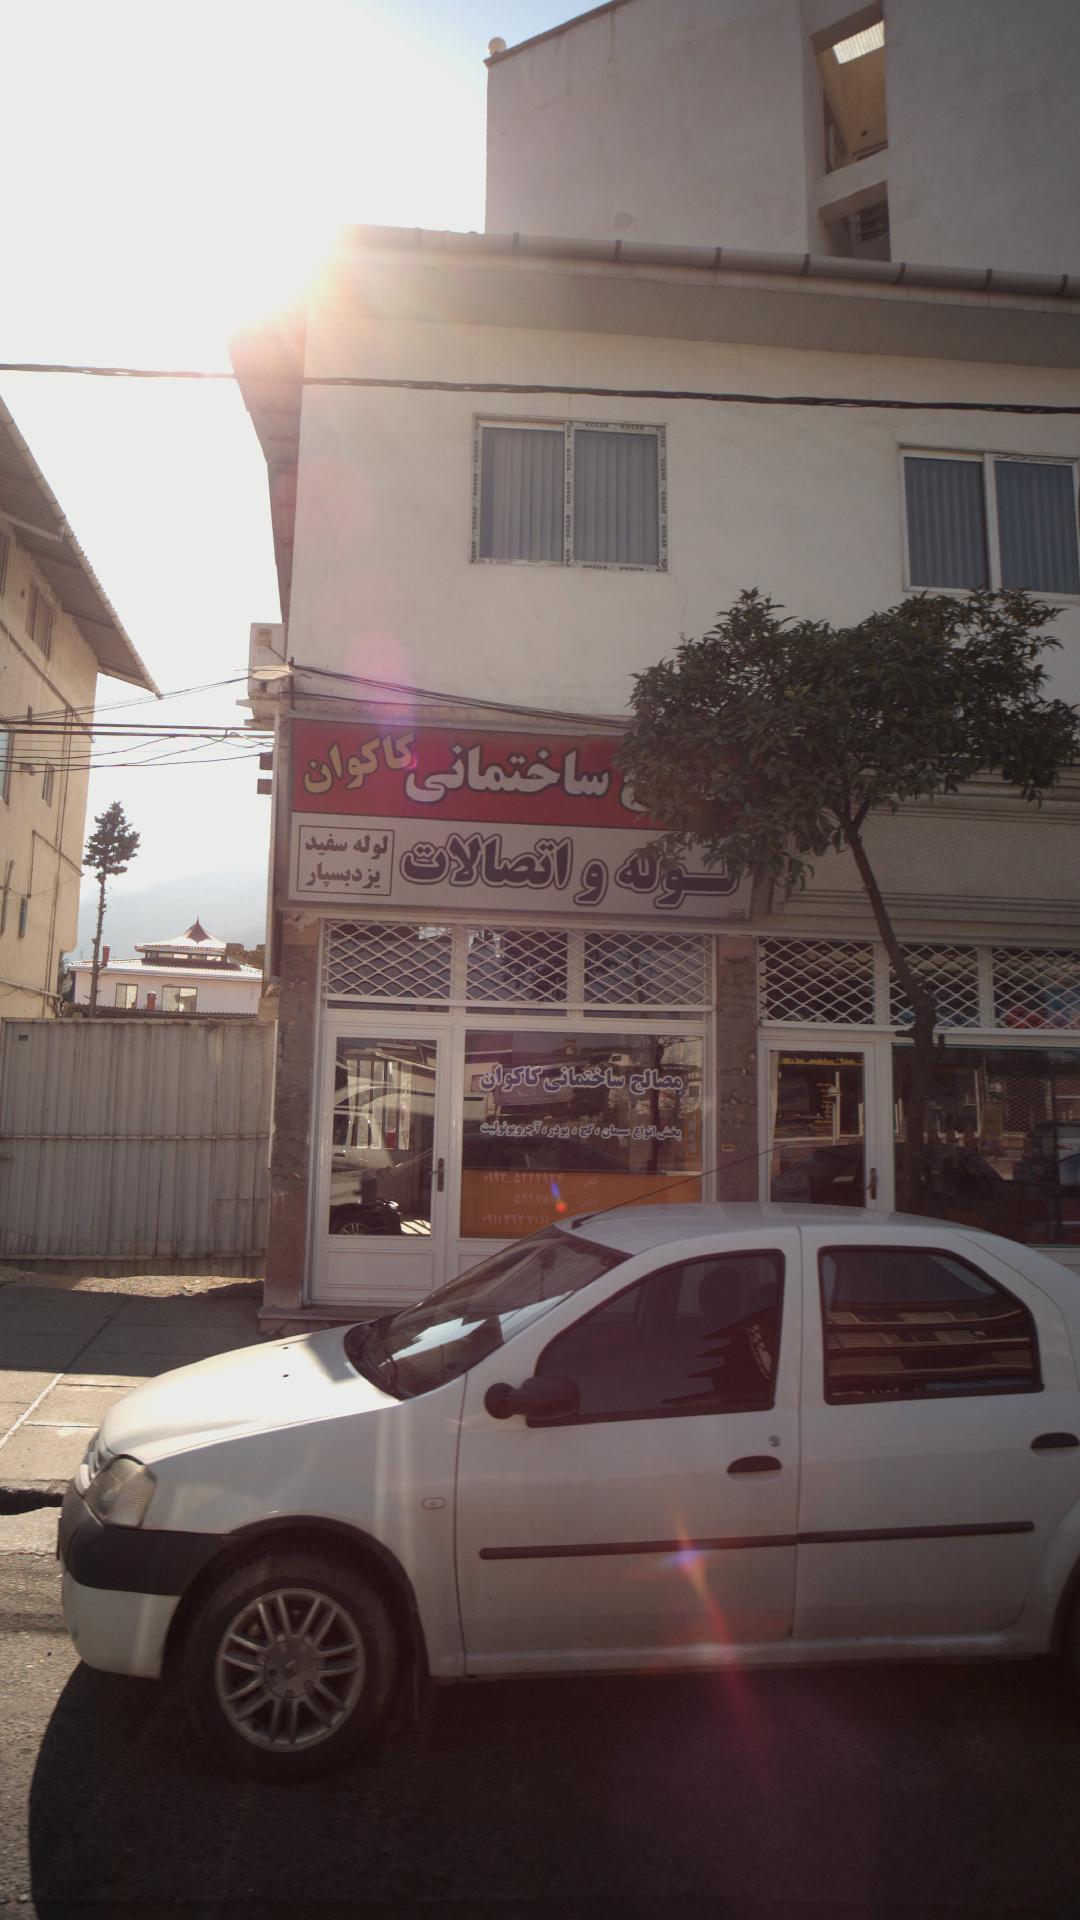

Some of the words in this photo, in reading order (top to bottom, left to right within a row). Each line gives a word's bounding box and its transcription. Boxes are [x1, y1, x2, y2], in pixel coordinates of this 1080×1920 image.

[303, 728, 417, 794] کاکوان
[404, 743, 611, 804] ساختمانی
[305, 832, 348, 855] سفید
[352, 834, 389, 859] لوله
[400, 832, 575, 891] اتصالات
[574, 860, 608, 906] و
[479, 1064, 542, 1091] کاکوان
[543, 1064, 626, 1092] ساختمانی
[632, 1124, 656, 1140] انواع
